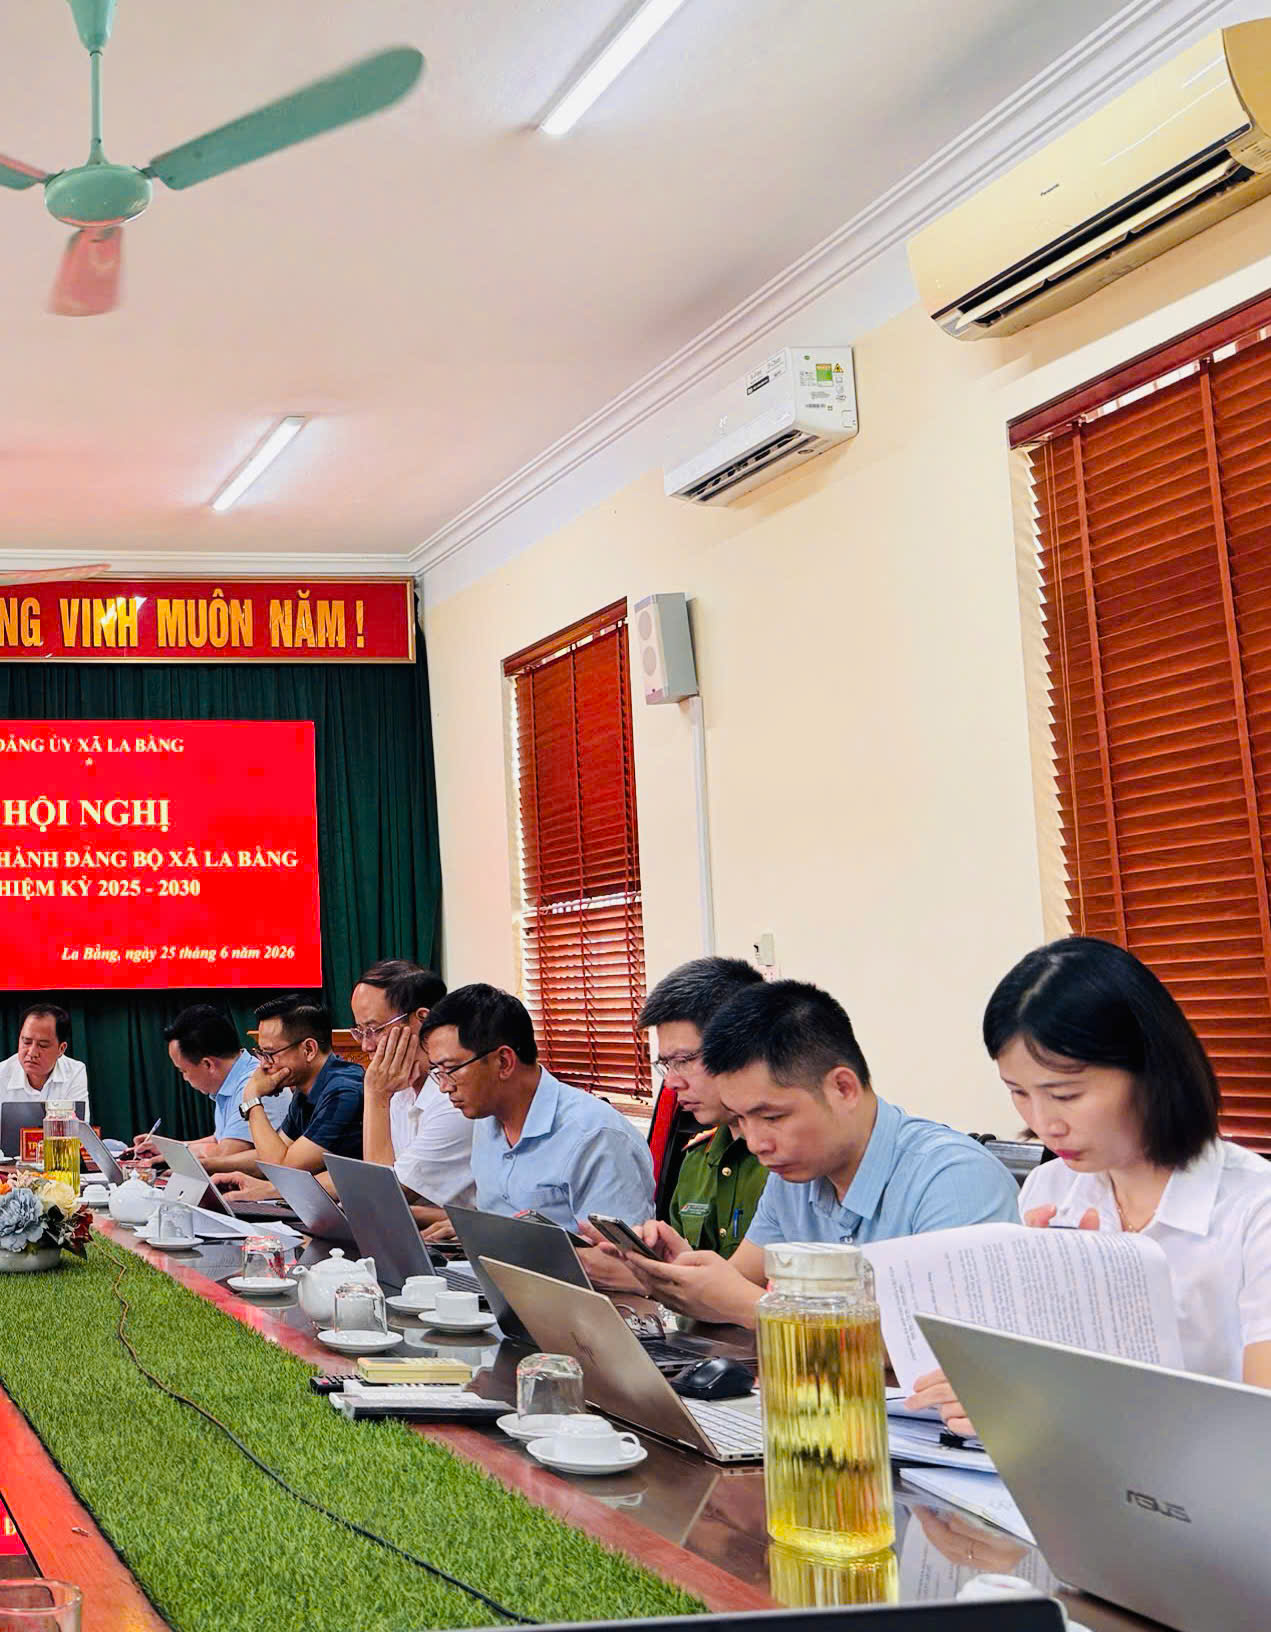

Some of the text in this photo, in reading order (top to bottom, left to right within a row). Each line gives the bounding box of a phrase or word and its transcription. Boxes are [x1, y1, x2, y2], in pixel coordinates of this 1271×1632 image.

[59, 596, 140, 648] VINH
[157, 588, 253, 648] MUÔN
[77, 735, 103, 753] XÃ
[107, 738, 131, 753] LA
[2, 796, 170, 833] HỘI NGHỊ
[65, 845, 127, 868] ĐẢNG
[133, 848, 164, 871] BỘ
[168, 847, 199, 868] XÃ
[204, 850, 233, 868] LA
[61, 875, 92, 897] KỲ
[98, 879, 141, 897] 2025
[158, 879, 201, 897] 2030
[61, 947, 79, 961] La
[125, 946, 157, 963] ngày
[160, 945, 177, 959] 25
[179, 945, 217, 963] tháng
[220, 945, 229, 959] 6
[231, 946, 261, 959] năm
[264, 945, 295, 959] 2026
[1126, 1490, 1192, 1524] ASUS
